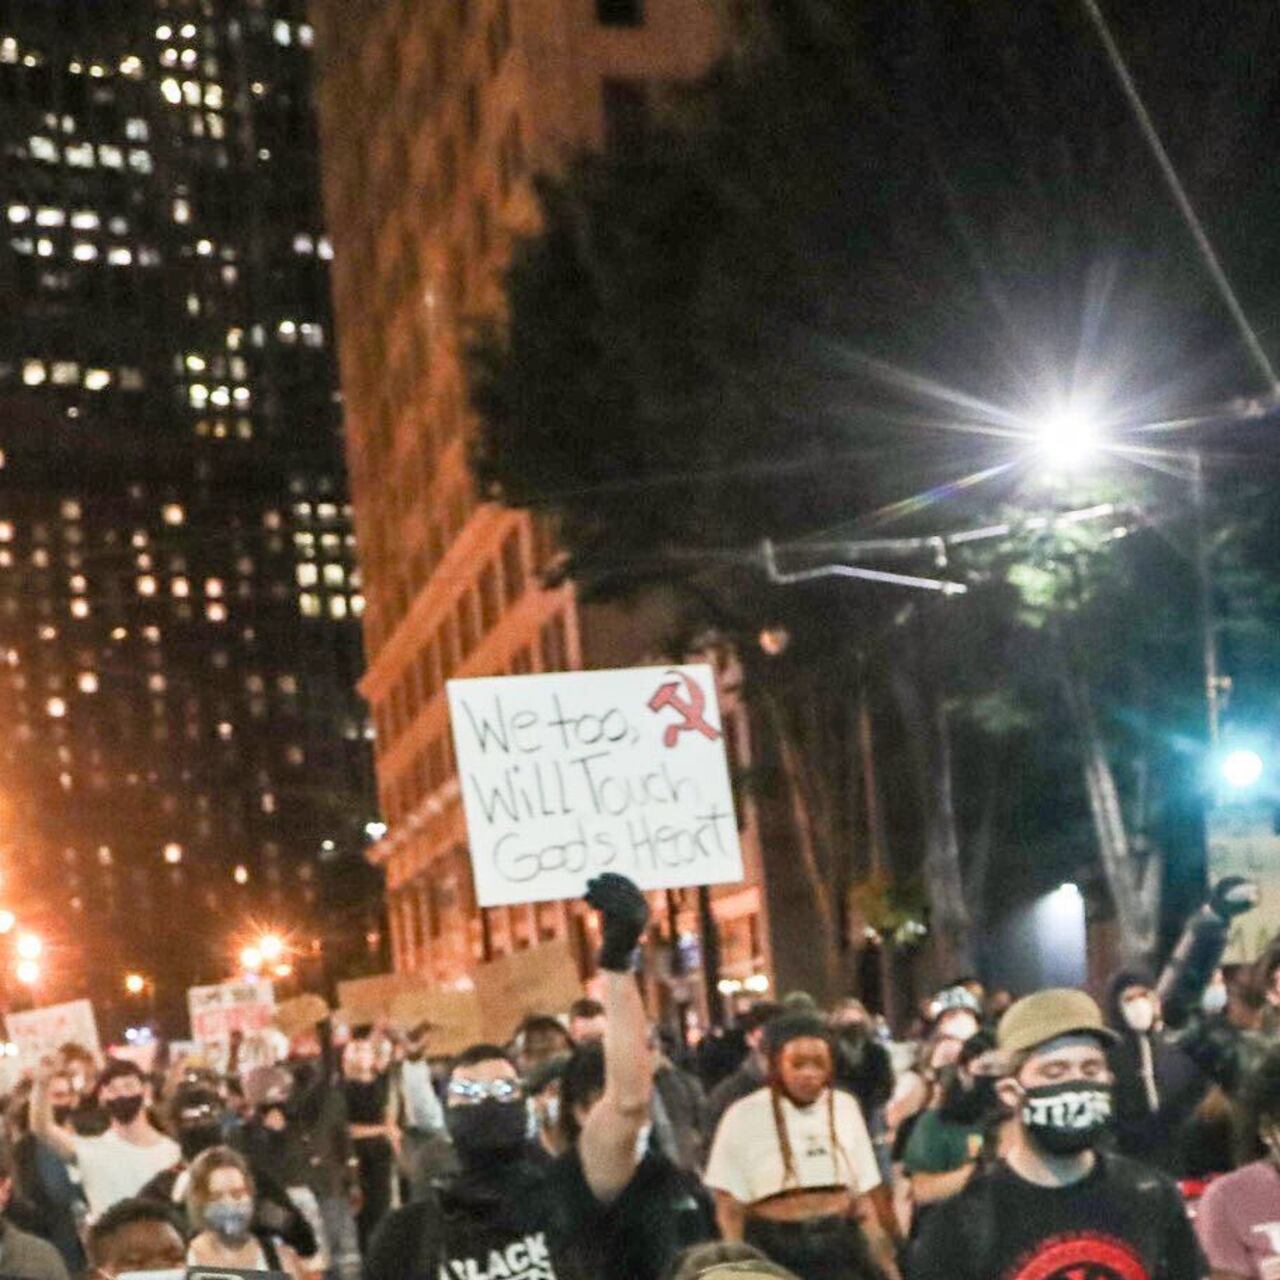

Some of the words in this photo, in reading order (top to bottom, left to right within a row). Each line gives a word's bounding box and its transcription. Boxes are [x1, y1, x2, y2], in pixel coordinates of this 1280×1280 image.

[460, 694, 543, 754] We
[548, 693, 640, 749] too,
[570, 751, 701, 816] Touch
[627, 803, 731, 871] Heart
